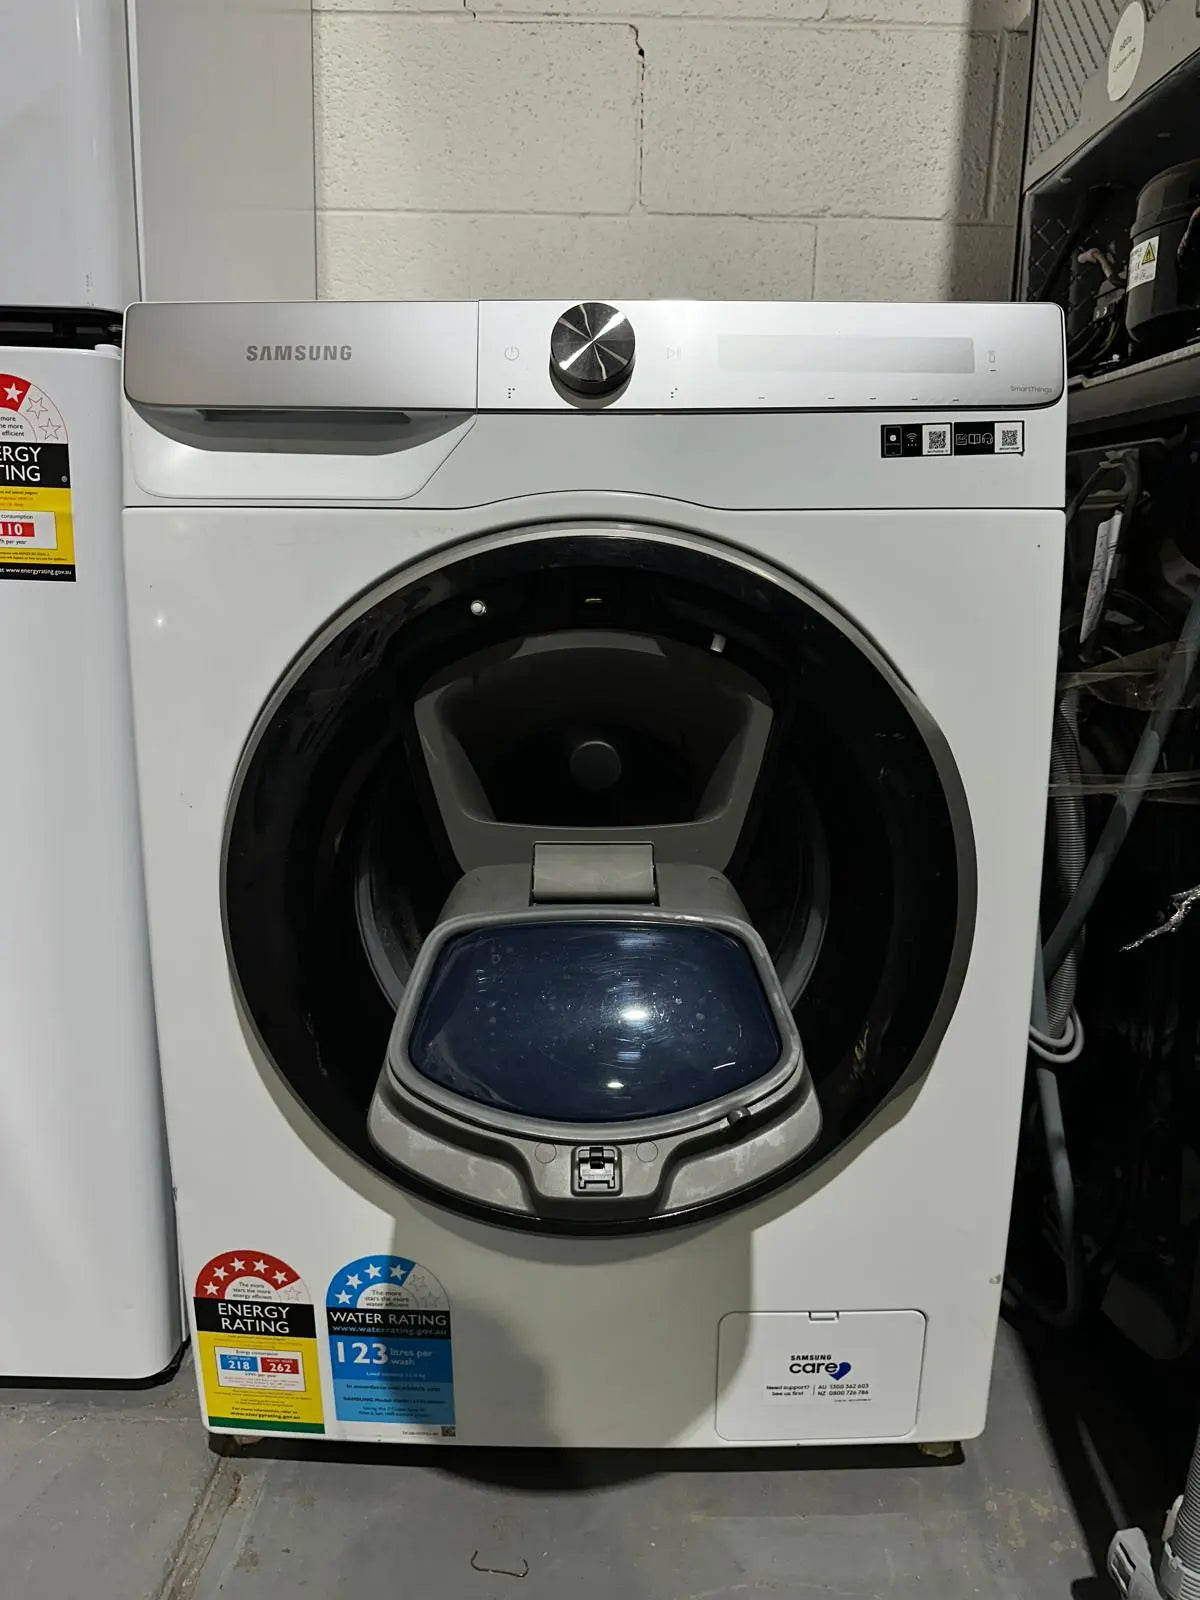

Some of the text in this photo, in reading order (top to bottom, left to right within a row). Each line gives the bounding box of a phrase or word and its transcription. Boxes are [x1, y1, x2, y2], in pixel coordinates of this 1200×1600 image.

[246, 345, 353, 361] SAMSUNG
[1009, 385, 1053, 395] SmartThings
[217, 1303, 290, 1319] ENERGY
[330, 1311, 447, 1326] WATER RATING
[221, 1318, 290, 1334] RATING
[332, 1325, 447, 1336] www.waterrating.gov.au
[416, 1350, 432, 1359] per
[228, 1361, 250, 1370] 218
[269, 1363, 292, 1373] 262
[789, 1362, 838, 1374] care
